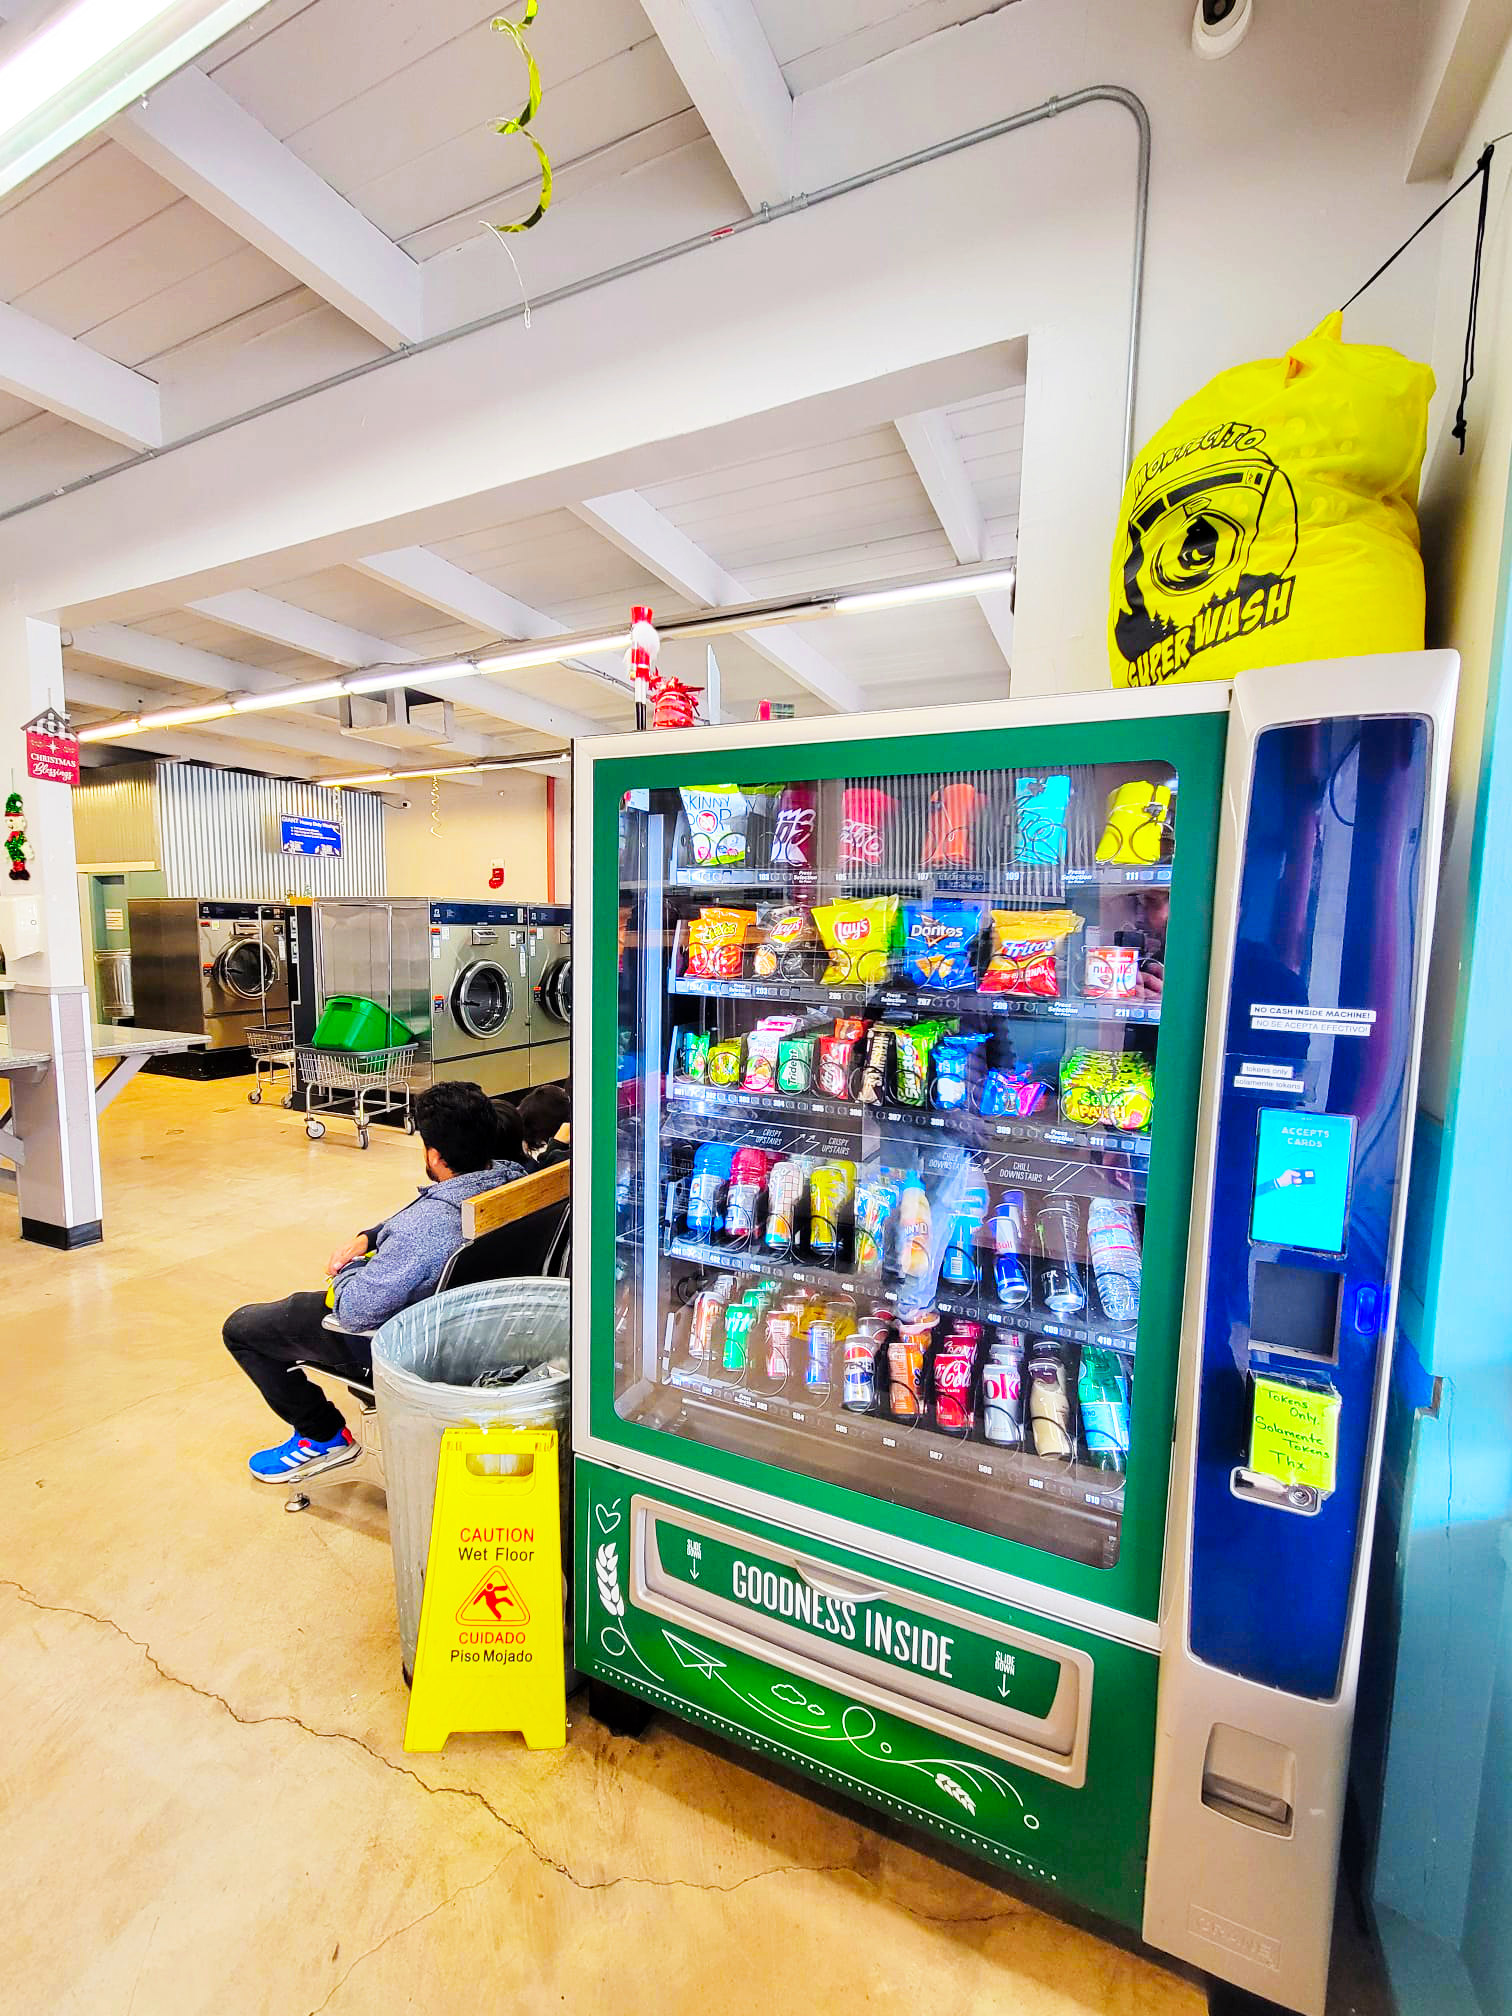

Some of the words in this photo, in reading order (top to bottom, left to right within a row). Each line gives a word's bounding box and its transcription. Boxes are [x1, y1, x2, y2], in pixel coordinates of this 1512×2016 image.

[1127, 626, 1192, 688] SUPER
[1192, 575, 1297, 652] WASH
[30, 753, 77, 768] CHRISTMAS
[32, 762, 74, 780] Blessings
[684, 794, 731, 811] SKINNY
[917, 872, 929, 881] 107
[1061, 873, 1092, 882] Selection
[1068, 868, 1085, 876] Press
[1125, 871, 1139, 880] 111
[910, 925, 964, 938] Doritos
[1002, 939, 1055, 957] Fritos
[881, 996, 907, 1005] Selection
[1055, 1001, 1073, 1009] Press
[1047, 1006, 1079, 1014] Selection
[1115, 1008, 1131, 1018] 211
[1295, 1009, 1323, 1017] INSIDE
[1326, 1011, 1371, 1019] MACHINE!
[1284, 1022, 1318, 1031] ACEPTA
[1321, 1024, 1369, 1033] EFECTIVO!
[787, 1048, 799, 1086] Trident
[1272, 1068, 1289, 1077] only
[1235, 1078, 1274, 1088] solamente
[1078, 1104, 1127, 1119] PATCH
[763, 1129, 783, 1138] CRISPY
[1050, 1129, 1069, 1137] Press
[1281, 1126, 1329, 1138] ACCEPTS
[756, 1136, 783, 1146] UPSTAIRS
[828, 1137, 849, 1146] CRISPY
[1044, 1133, 1075, 1143] Selection
[1090, 1137, 1105, 1146] 311
[1287, 1137, 1322, 1148] CARDS
[822, 1144, 851, 1155] UPSTAIRS
[1013, 1161, 1031, 1172] CHILL
[1000, 1168, 1043, 1183] DOWNSTAIRS
[792, 1272, 805, 1282] 404
[938, 1302, 952, 1312] 407
[1097, 1336, 1112, 1346] 410
[1262, 1387, 1308, 1409] Tokens
[1255, 1415, 1324, 1446] Solamente
[459, 1528, 535, 1543] CAUTION
[686, 1538, 703, 1553] SLIDE
[458, 1547, 488, 1562] Wet
[495, 1547, 535, 1563] Floor
[686, 1547, 703, 1561] DOWN
[732, 1560, 857, 1641] GOODNESS
[865, 1606, 955, 1679] INSIDE
[458, 1632, 526, 1645] CUIDADO
[450, 1649, 481, 1663] Piso
[483, 1649, 533, 1666] Mojado
[995, 1649, 1016, 1668] SLIDE
[994, 1661, 1016, 1677] DOWN
